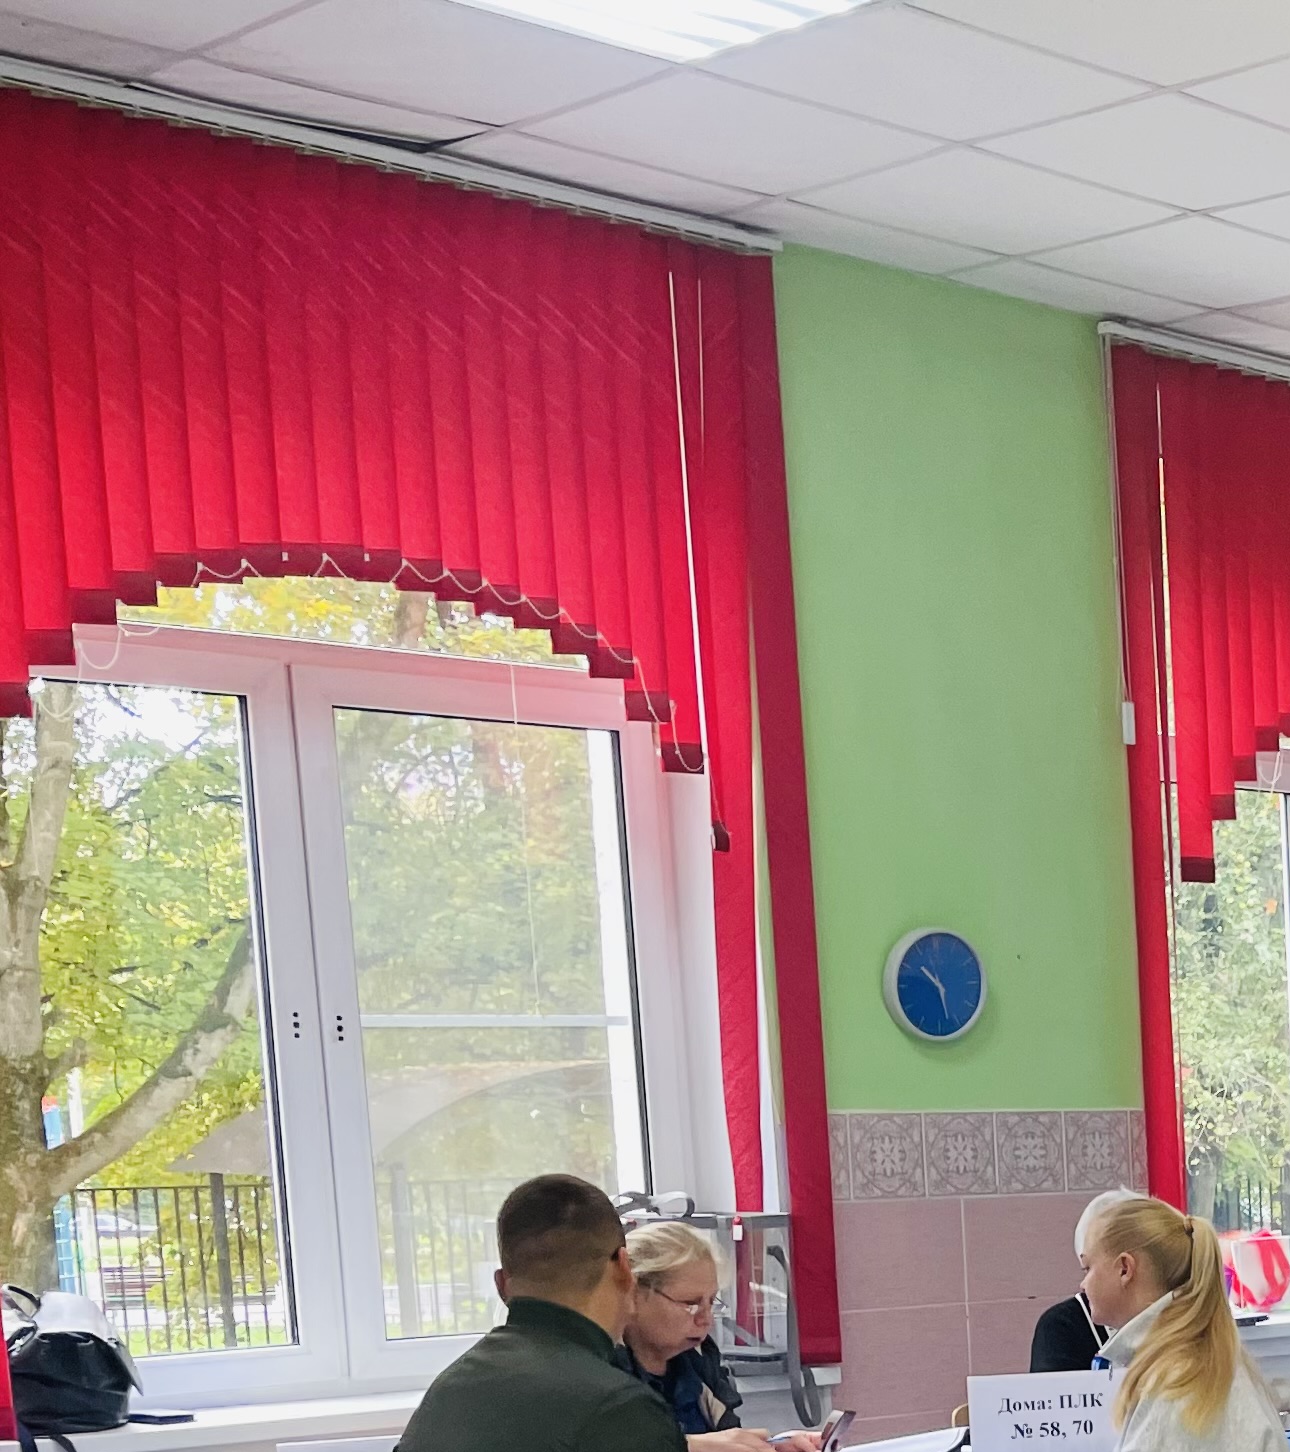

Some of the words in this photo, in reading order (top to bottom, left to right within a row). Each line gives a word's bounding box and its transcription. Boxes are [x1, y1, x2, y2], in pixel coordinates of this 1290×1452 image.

[997, 1397, 1052, 1416] Дома:
[1059, 1392, 1103, 1409] ПЛК
[1010, 1423, 1033, 1440] №
[1039, 1421, 1067, 1439] 58,
[1072, 1419, 1094, 1436] 70
